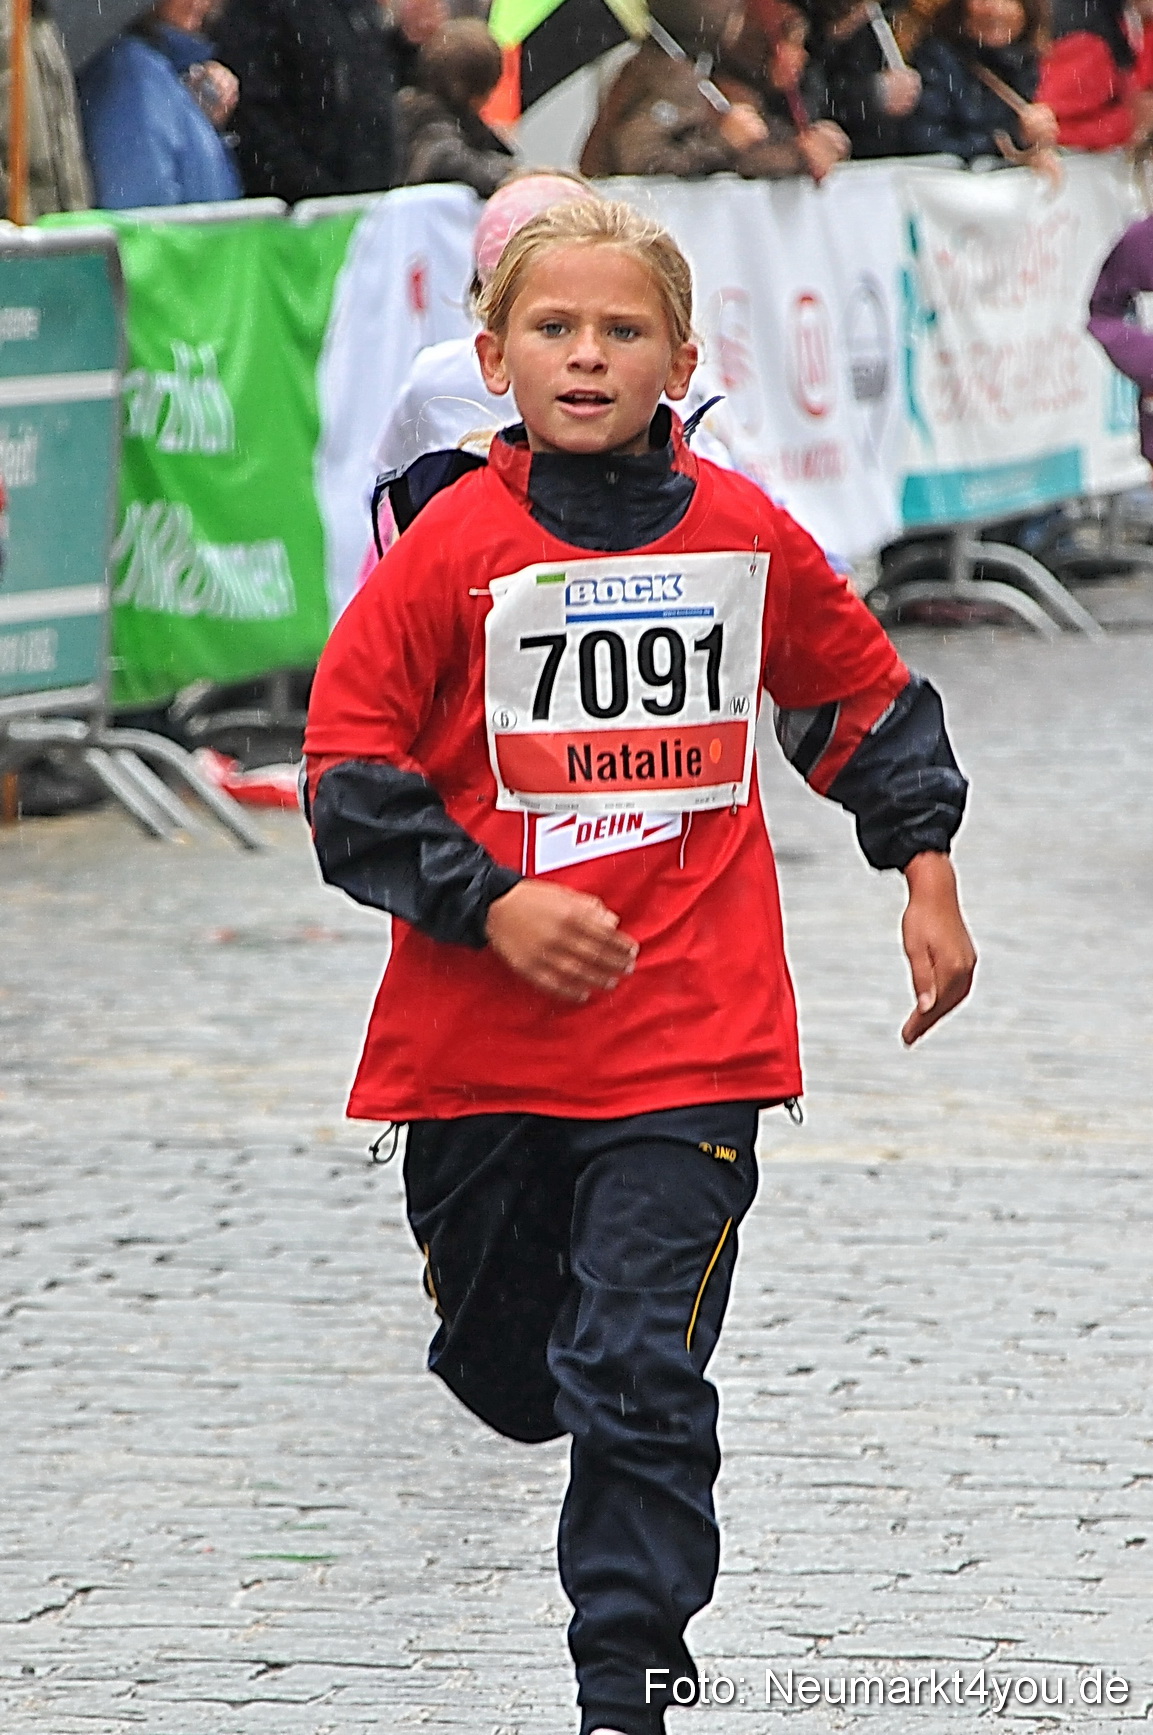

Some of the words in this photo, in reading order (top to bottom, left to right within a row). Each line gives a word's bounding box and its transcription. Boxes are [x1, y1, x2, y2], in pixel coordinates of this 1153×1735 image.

[565, 573, 684, 607] BOCK
[519, 622, 724, 721] 7091
[732, 697, 746, 713] W
[566, 739, 702, 784] Natalie
[575, 812, 644, 847] DEHN
[714, 1144, 737, 1163] JAKO
